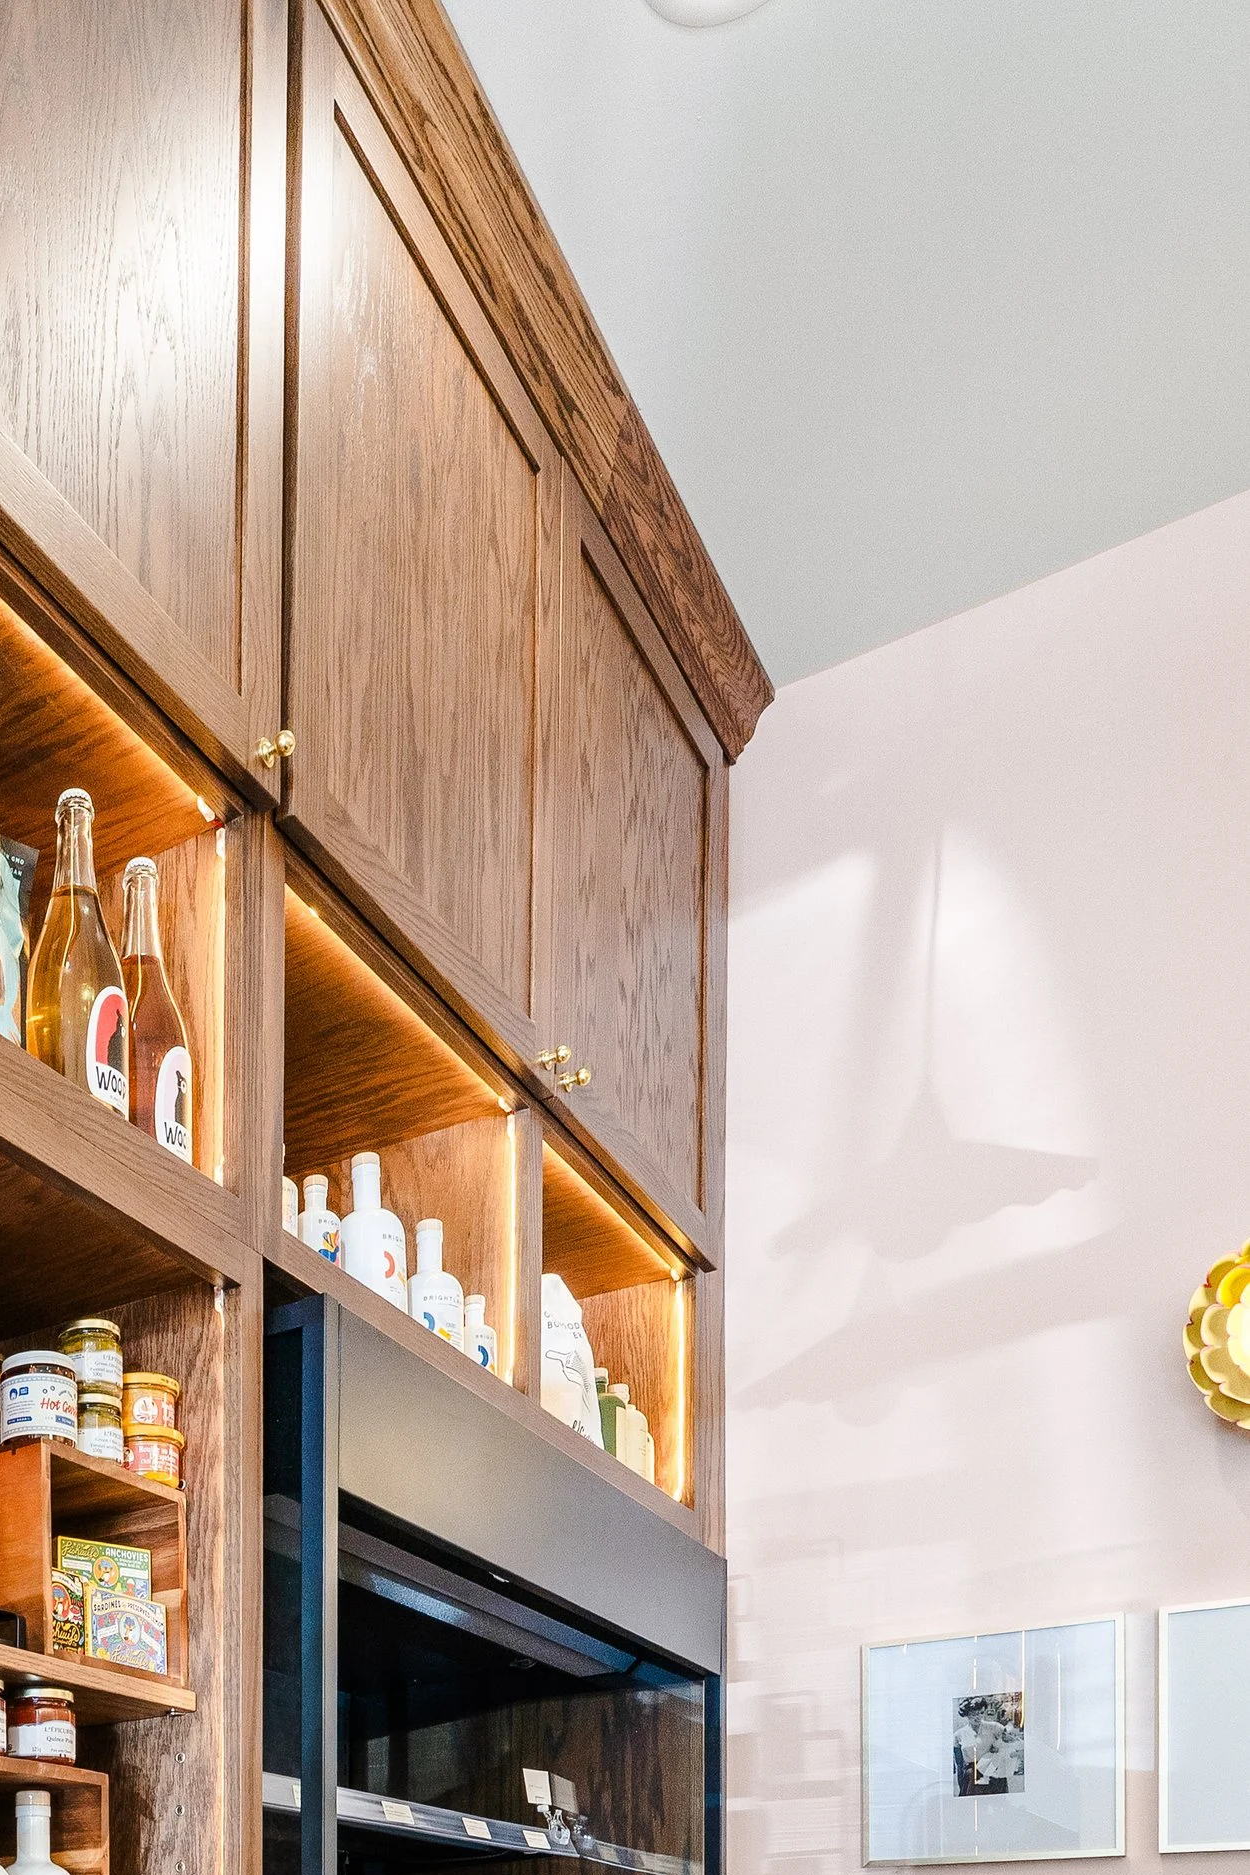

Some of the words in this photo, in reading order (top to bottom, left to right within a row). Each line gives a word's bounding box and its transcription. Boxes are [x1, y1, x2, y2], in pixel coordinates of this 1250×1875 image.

[40, 1396, 61, 1411] Hot
[105, 1547, 149, 1561] ANCHOVIES
[93, 1600, 121, 1613] SARDINES
